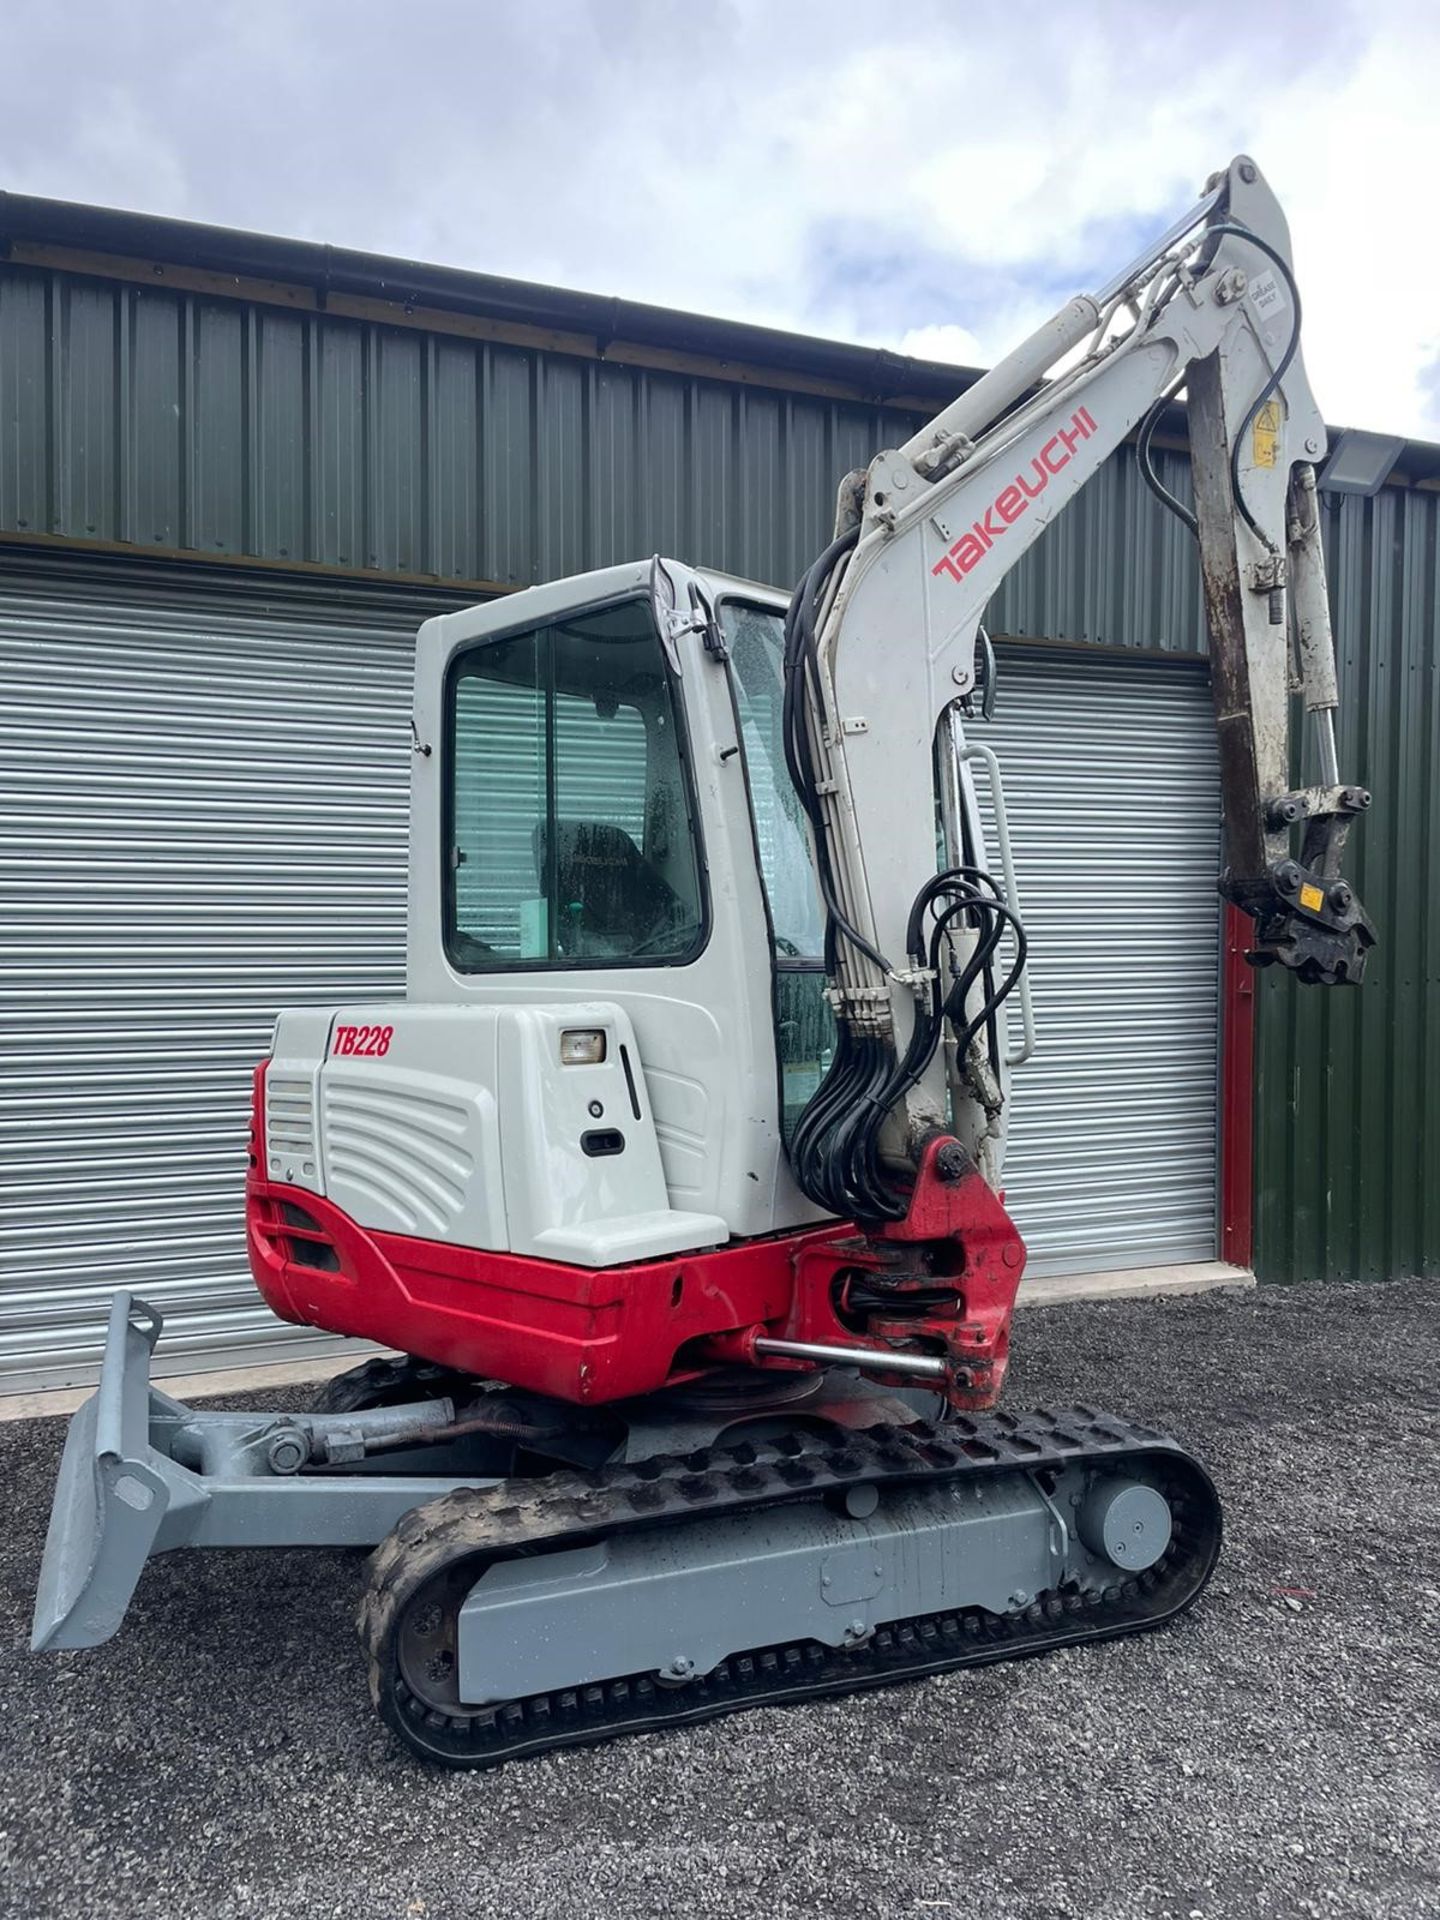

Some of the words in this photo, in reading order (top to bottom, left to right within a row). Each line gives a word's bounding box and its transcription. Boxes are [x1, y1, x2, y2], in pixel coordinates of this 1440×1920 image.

[1251, 280, 1276, 301] GREASE
[1259, 291, 1276, 308] DAILY
[333, 1025, 394, 1057] TB228
